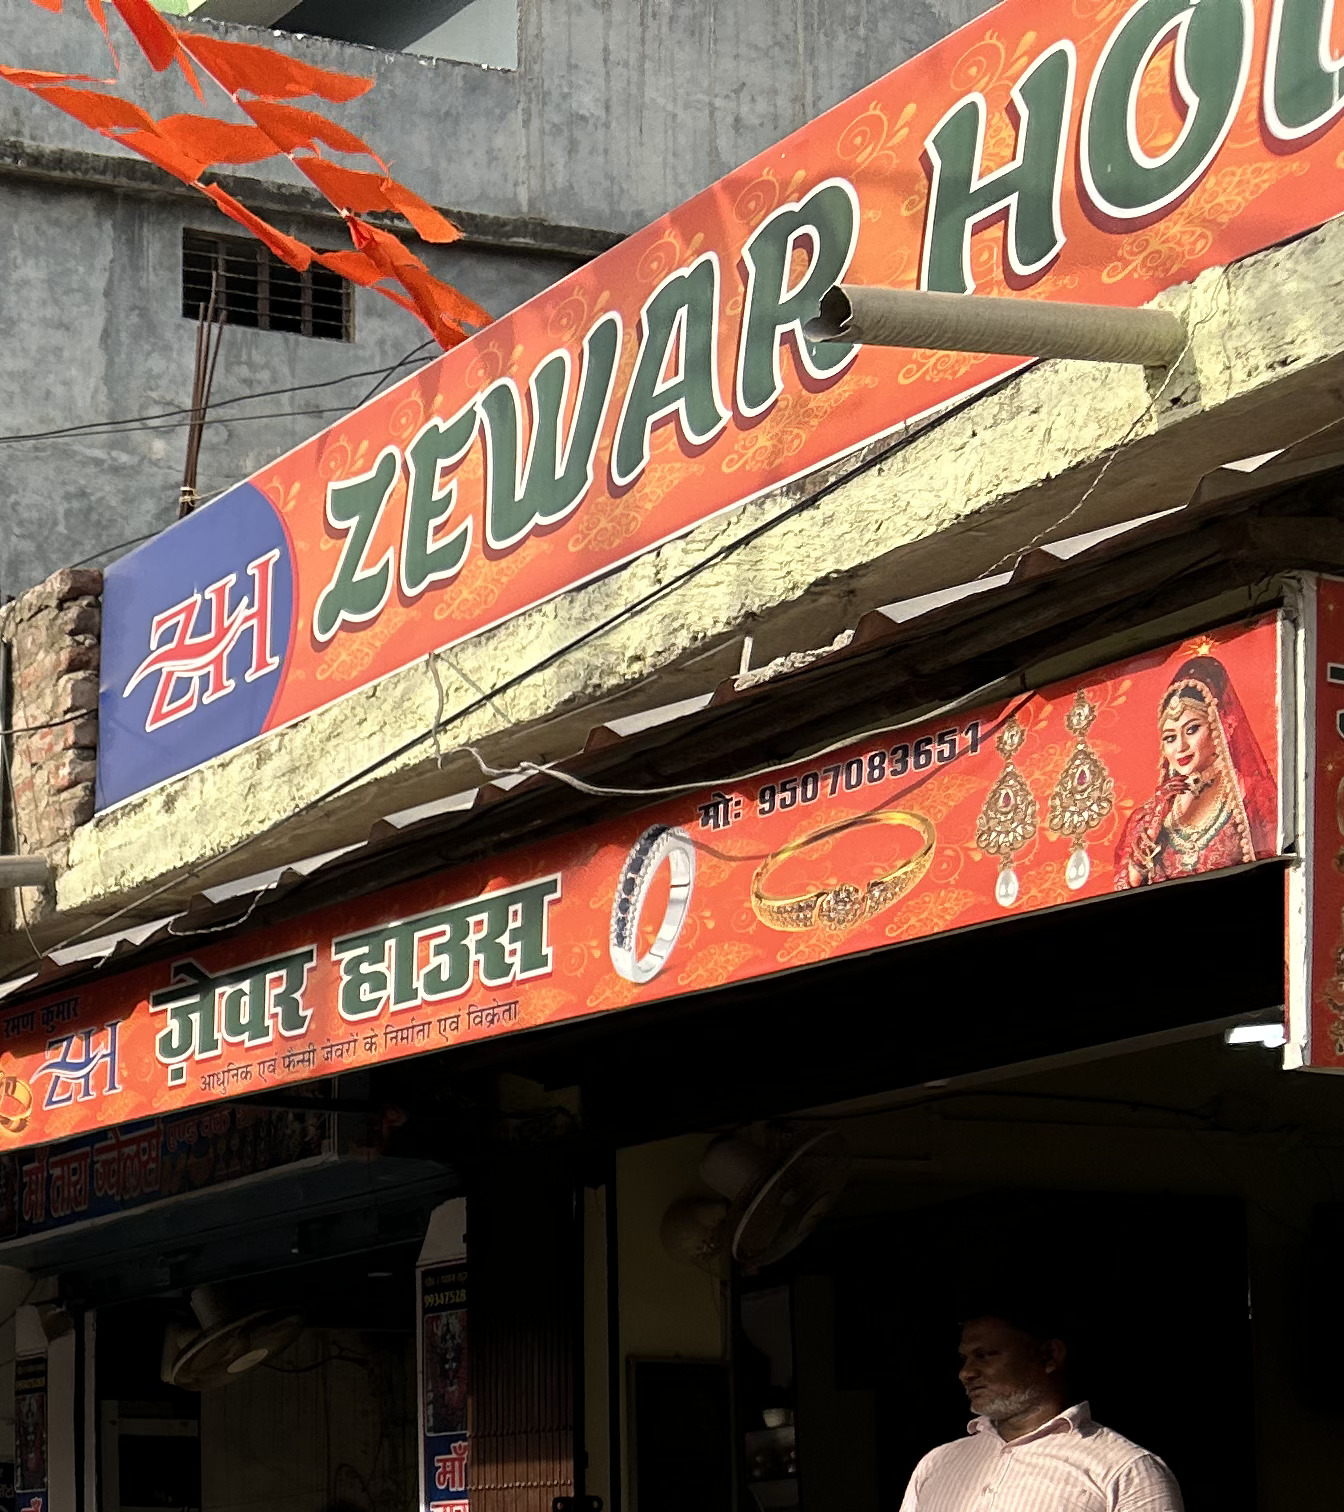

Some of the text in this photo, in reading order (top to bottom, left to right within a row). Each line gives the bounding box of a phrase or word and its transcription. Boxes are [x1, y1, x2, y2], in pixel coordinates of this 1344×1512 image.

[312, 176, 861, 645] ZEWAR
[758, 720, 982, 820] 9507083651
[40, 996, 79, 1033] कुमार
[150, 874, 562, 1087] ज़ेवर हाउस
[200, 1062, 253, 1095] आधुनिक
[258, 1050, 277, 1083] एवं
[363, 1026, 378, 1053] के
[438, 1007, 461, 1042] एवं
[466, 998, 519, 1032] विक्रेता
[49, 1150, 90, 1218] तारा
[435, 1442, 468, 1492] माँ
